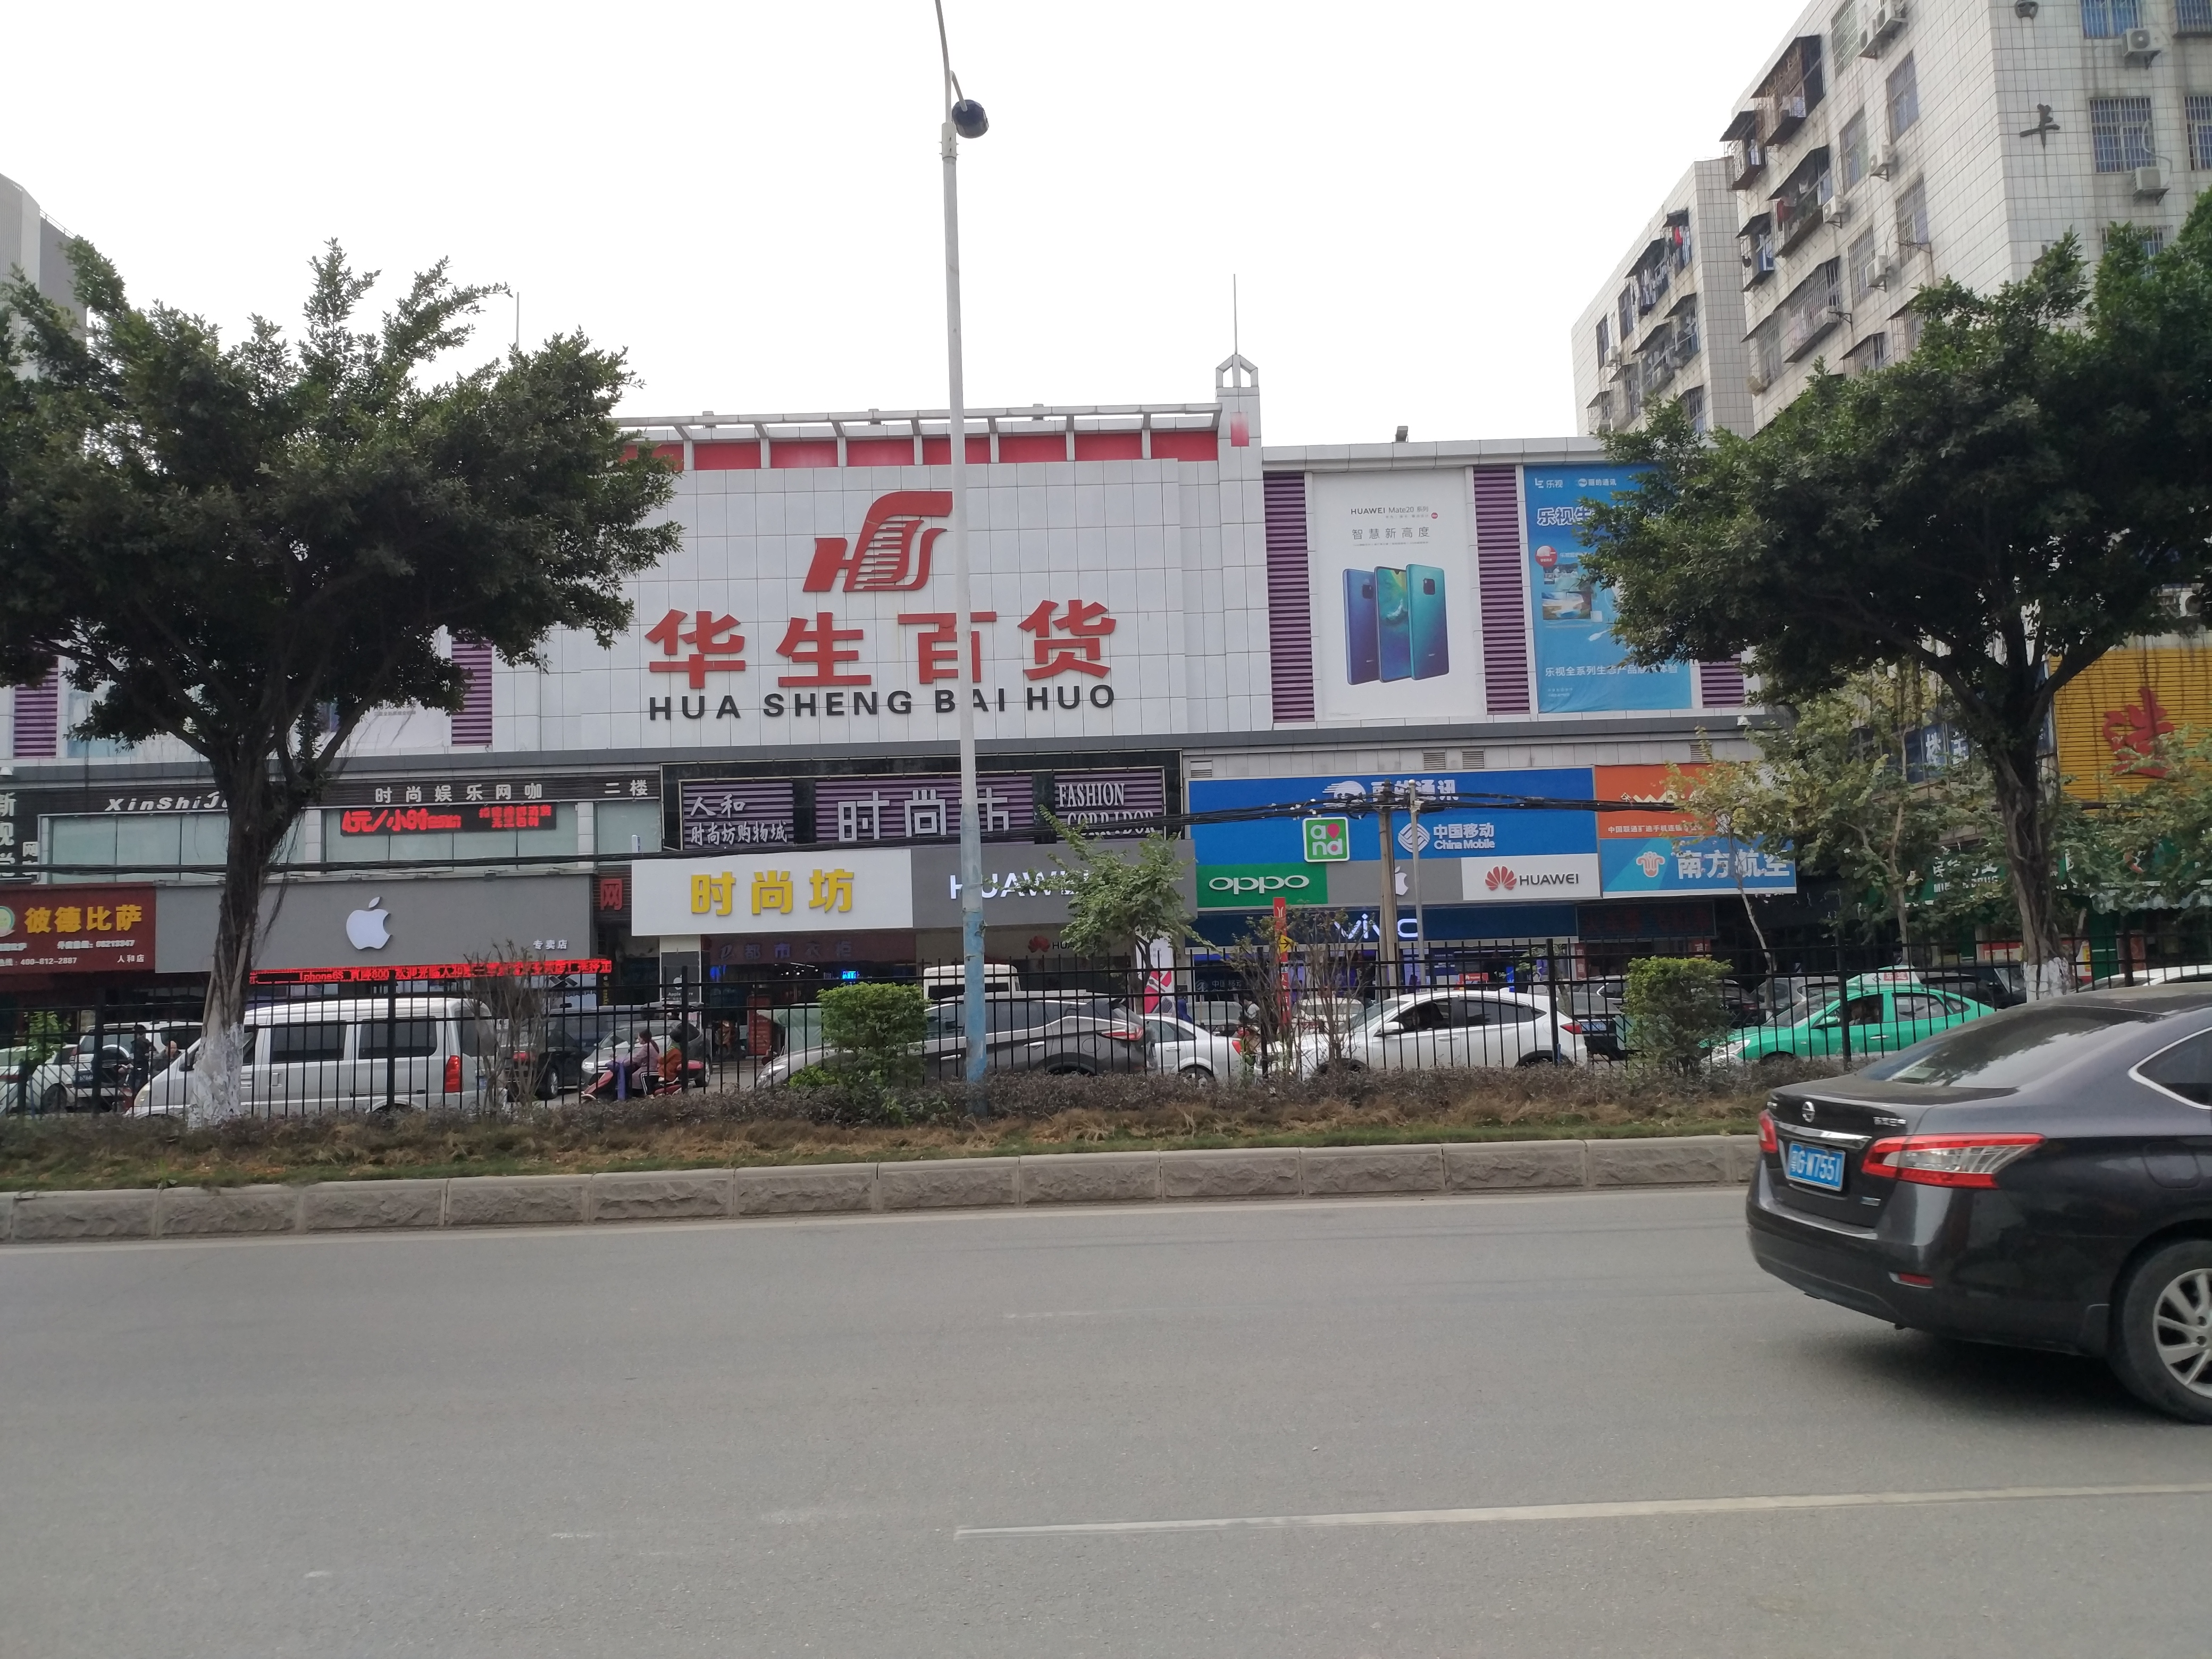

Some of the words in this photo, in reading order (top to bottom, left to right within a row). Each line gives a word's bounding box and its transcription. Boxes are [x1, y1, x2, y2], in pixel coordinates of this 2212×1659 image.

[1546, 480, 1563, 488] 乐视
[1352, 526, 1430, 540] 智慧新高度
[645, 599, 1117, 689] 华生百货
[650, 696, 741, 721] HUA
[763, 690, 912, 717] SHENG
[935, 688, 1005, 713] BAI
[1027, 684, 1115, 711] HUO
[375, 783, 543, 803] 时尚娱乐网咖
[605, 779, 649, 796] 二楼
[1058, 782, 1125, 808] FASHION
[690, 793, 745, 818] 人和
[691, 819, 787, 847] 时尚坊购物城
[1434, 823, 1494, 839] 中国移动
[1434, 840, 1462, 850] China
[1463, 839, 1495, 849] Mobile
[1519, 873, 1579, 886] HUAWEI
[600, 878, 623, 910] 网
[691, 869, 854, 915] 时尚坊
[24, 904, 143, 934] 彼德比萨
[533, 940, 568, 950] 专卖店
[117, 954, 145, 963] 人和店
